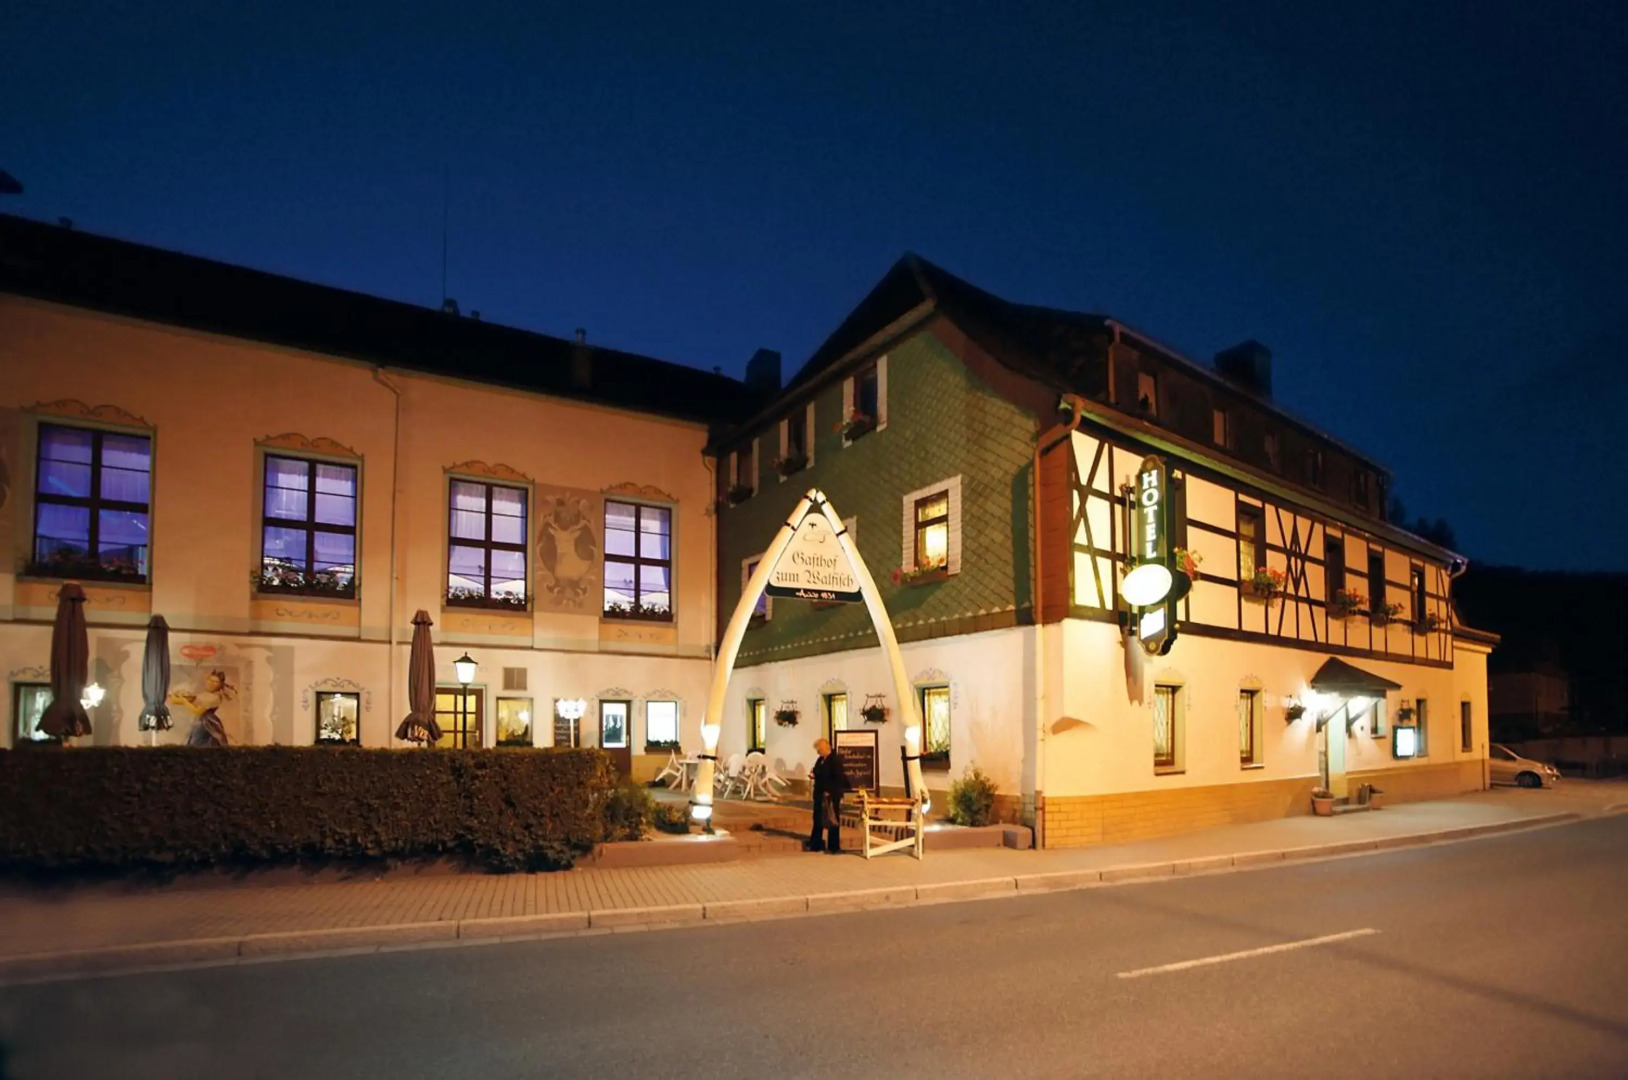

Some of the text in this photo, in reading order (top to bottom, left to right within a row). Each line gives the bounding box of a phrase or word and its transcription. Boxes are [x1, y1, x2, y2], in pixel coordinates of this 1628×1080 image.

[1141, 469, 1159, 560] HOTEL
[792, 551, 838, 570] Gasthof
[776, 571, 799, 584] zum
